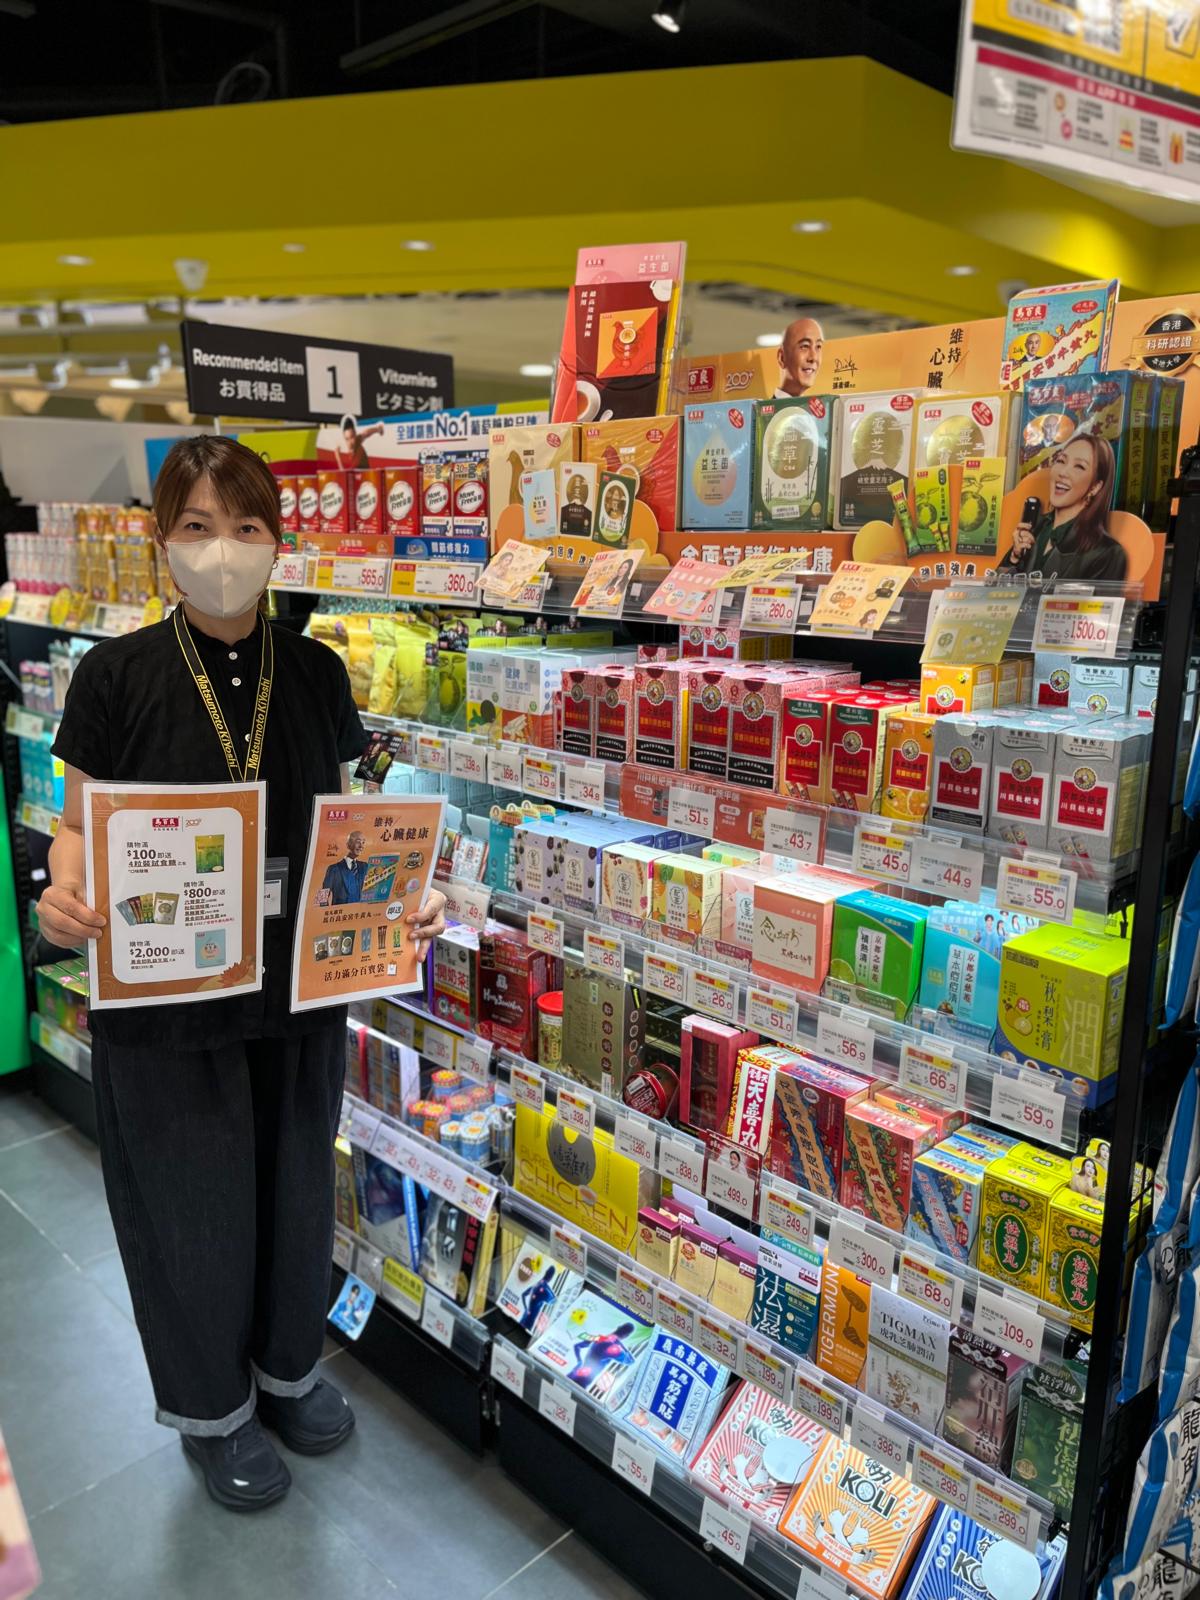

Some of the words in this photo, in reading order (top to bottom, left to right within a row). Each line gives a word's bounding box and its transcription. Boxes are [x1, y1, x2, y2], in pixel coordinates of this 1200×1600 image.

[1160, 320, 1182, 332] 香港
[949, 328, 964, 363] 維持
[1145, 336, 1192, 352] 科研認證
[192, 348, 276, 373] Recommended
[277, 356, 304, 376] item
[325, 365, 343, 399] 1
[378, 368, 438, 389] Vitamins
[219, 378, 286, 403] お買得品
[870, 417, 885, 456] 靈芝
[701, 456, 729, 471] 益生菌
[443, 574, 474, 593] $360.0
[764, 603, 793, 619] $260.0
[1063, 620, 1106, 640] $1,500.0
[196, 674, 224, 730] Matsumoto
[247, 712, 265, 769] Matsumoto
[999, 792, 1040, 806] 川貝枇杷膏
[1060, 802, 1104, 817] 川貝枇杷膏
[374, 817, 394, 828] 維持
[684, 809, 709, 826] $51.5
[380, 827, 430, 843] 心臟健康
[784, 833, 812, 851] $43.7
[127, 849, 156, 860] $100
[876, 853, 908, 873] $45.0
[936, 868, 972, 889] $44.9
[184, 887, 212, 898] $800
[1026, 887, 1065, 910] $55.0
[129, 947, 170, 958] $2,000
[324, 963, 385, 982] 活力滿分百寶袋
[766, 1013, 792, 1032] $51.0
[837, 1040, 866, 1061] $56.9
[924, 1071, 956, 1094] $66.3
[740, 1080, 764, 1152] 天喜丸
[1017, 1106, 1054, 1129] $59.0
[519, 1158, 629, 1236] CHICKEN
[581, 1215, 628, 1248] ESSENCE
[782, 1214, 808, 1236] $249.0
[856, 1252, 886, 1276] $300.0
[919, 1283, 950, 1307] $68.0
[880, 1310, 937, 1350] TIGMAX
[922, 1314, 941, 1329] Prime
[998, 1321, 1034, 1349] $109.0
[813, 1403, 840, 1425] $199.0
[873, 1437, 902, 1462] $398.0
[838, 1464, 898, 1520] KOLI
[936, 1477, 967, 1502] $299.0
[993, 1510, 1026, 1535] $299.0
[717, 1530, 741, 1552] $45.0
